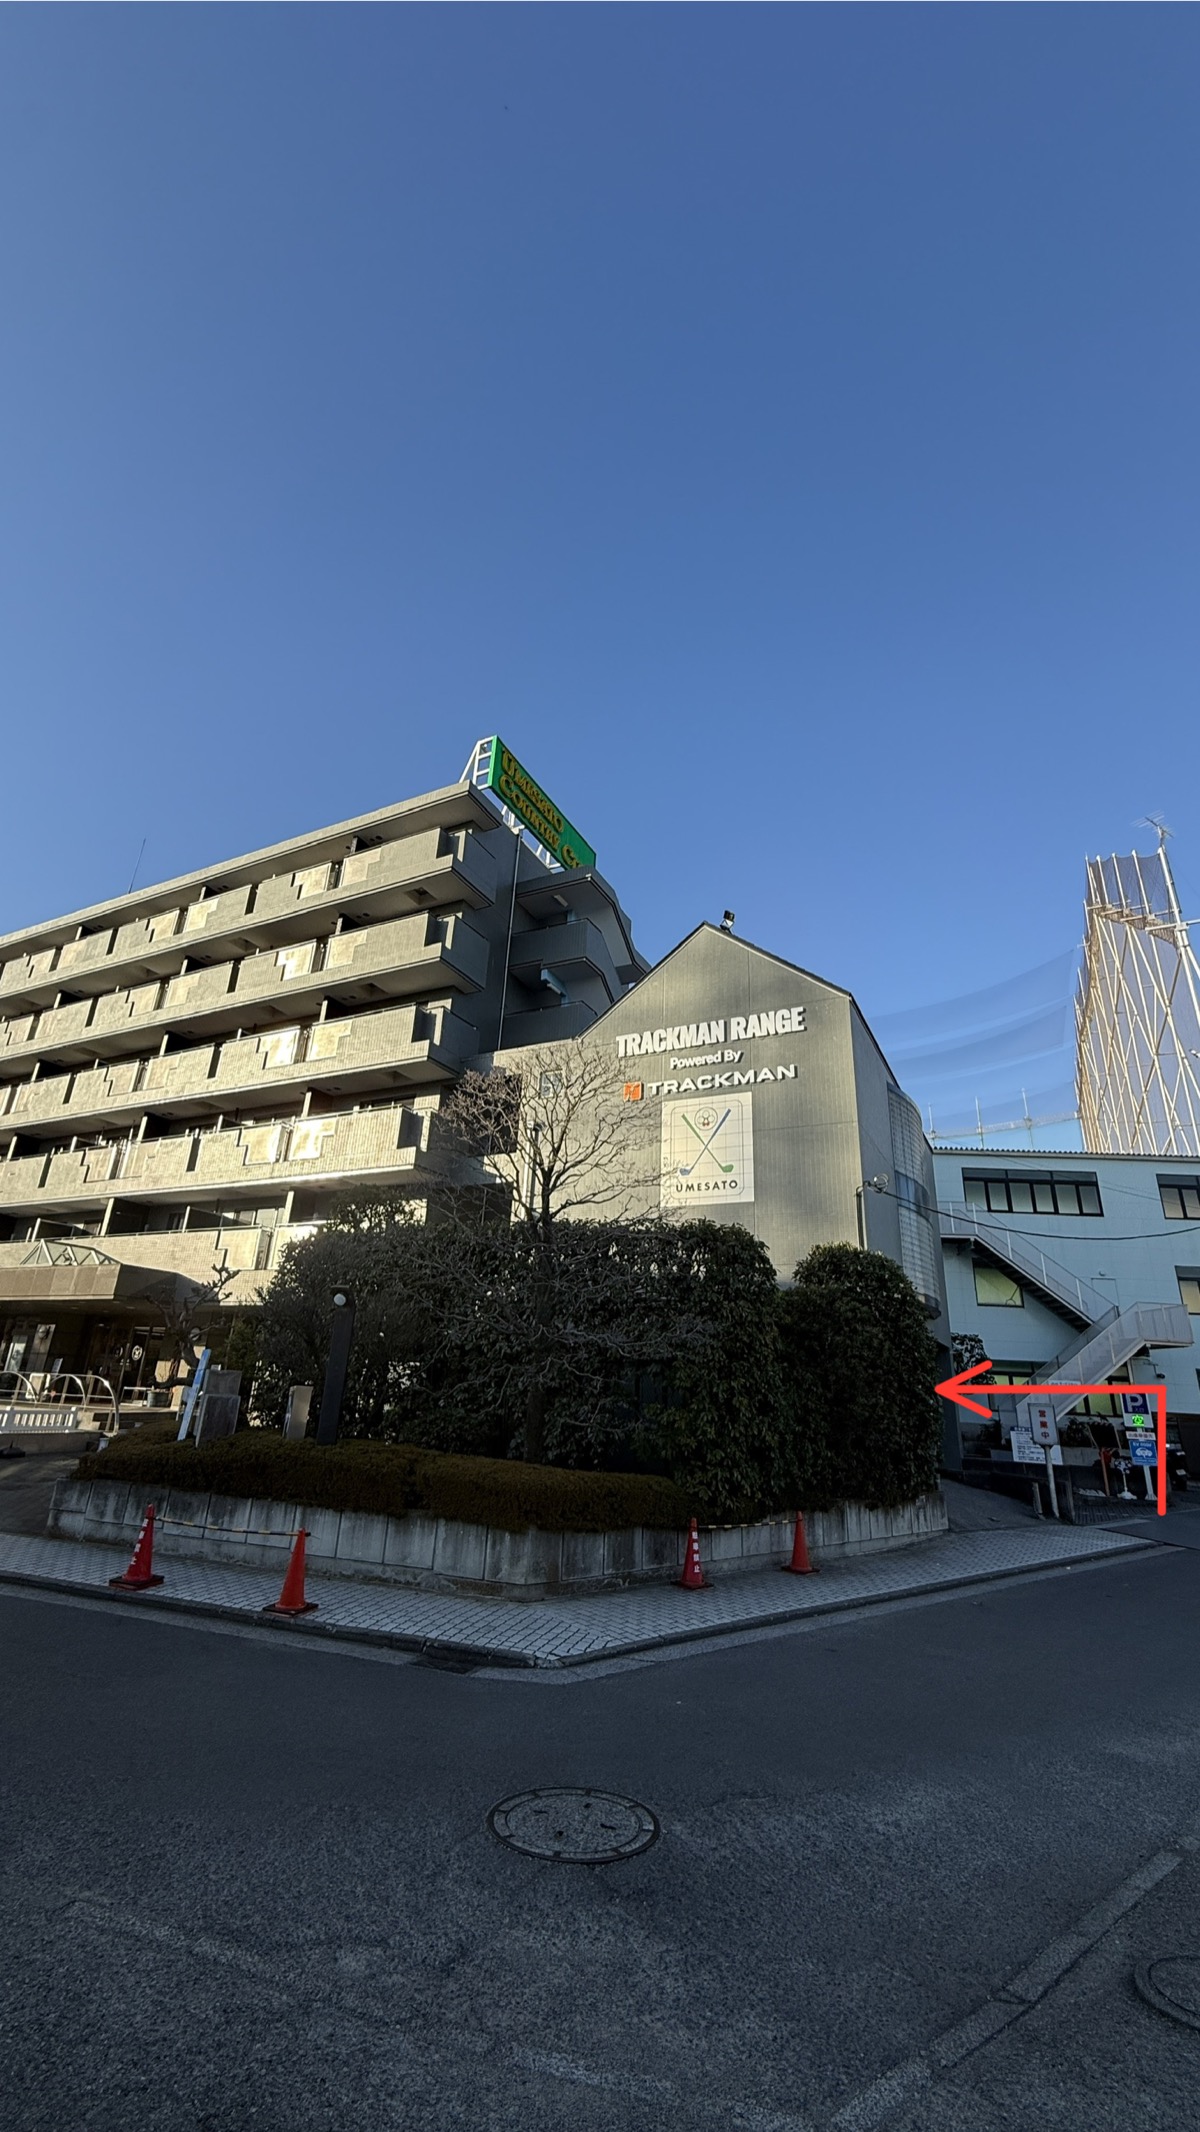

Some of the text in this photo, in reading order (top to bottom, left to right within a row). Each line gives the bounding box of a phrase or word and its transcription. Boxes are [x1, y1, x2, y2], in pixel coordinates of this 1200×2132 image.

[500, 774, 561, 851] COUNTRY
[616, 1007, 806, 1058] TRACKMAN RANGE
[670, 1049, 742, 1070] Powered By
[648, 1064, 796, 1096] TRACKMAN
[676, 1180, 738, 1192] UMESATO
[1126, 1393, 1143, 1412] P
[1038, 1409, 1049, 1439] 営業中
